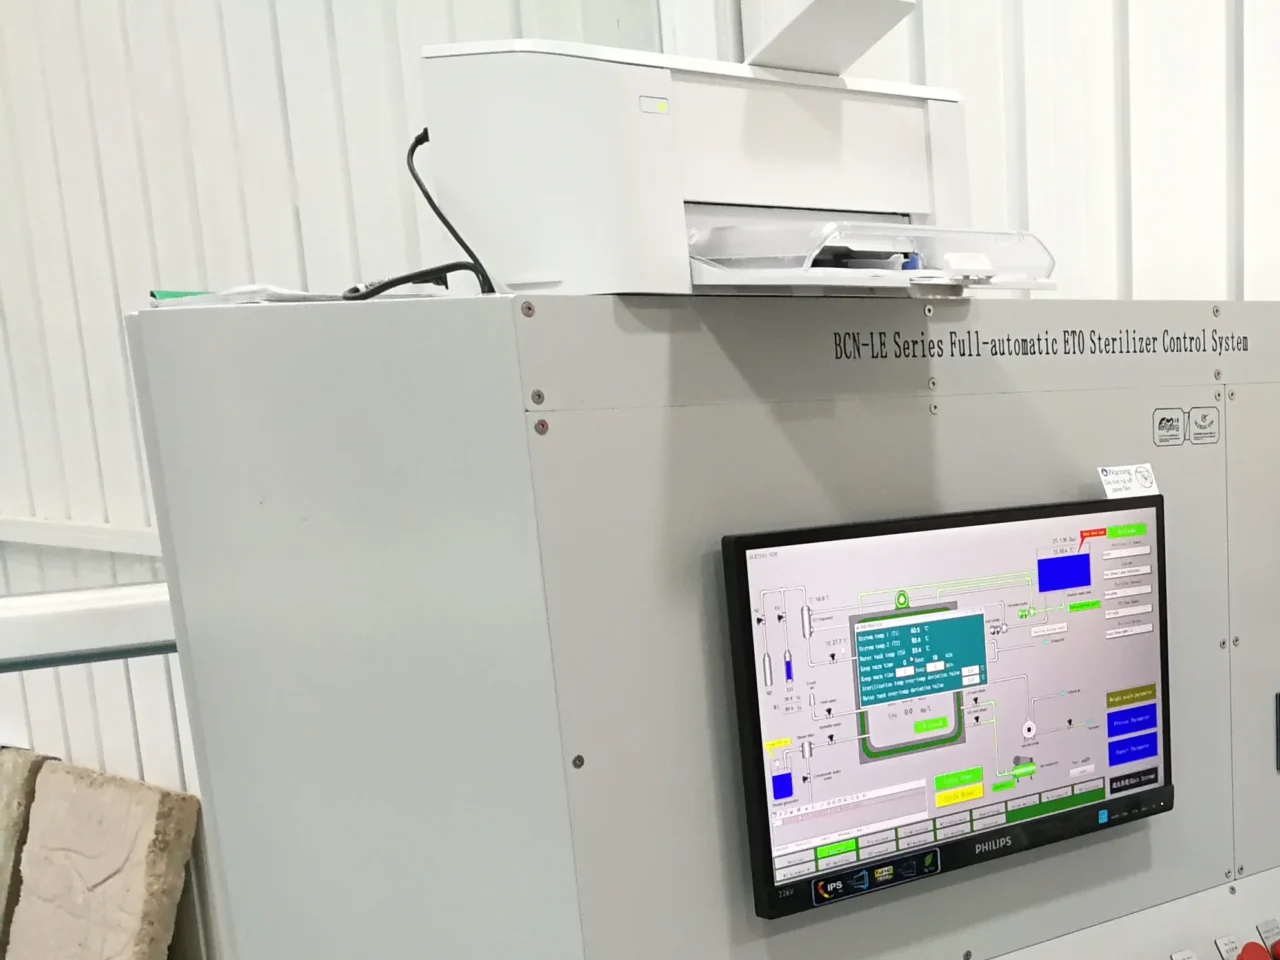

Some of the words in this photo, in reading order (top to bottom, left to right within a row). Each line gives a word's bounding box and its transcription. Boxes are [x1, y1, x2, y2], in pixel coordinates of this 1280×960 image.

[833, 331, 888, 360] BCN-LE
[893, 331, 944, 358] Series
[949, 329, 1058, 357] Full-automatic
[1063, 329, 1086, 355] ETO
[1090, 329, 1158, 355] Sterilizer
[1162, 328, 1207, 353] Control
[1212, 328, 1249, 356] System
[975, 836, 1012, 854] PHILIPS
[827, 880, 843, 891] IPS
